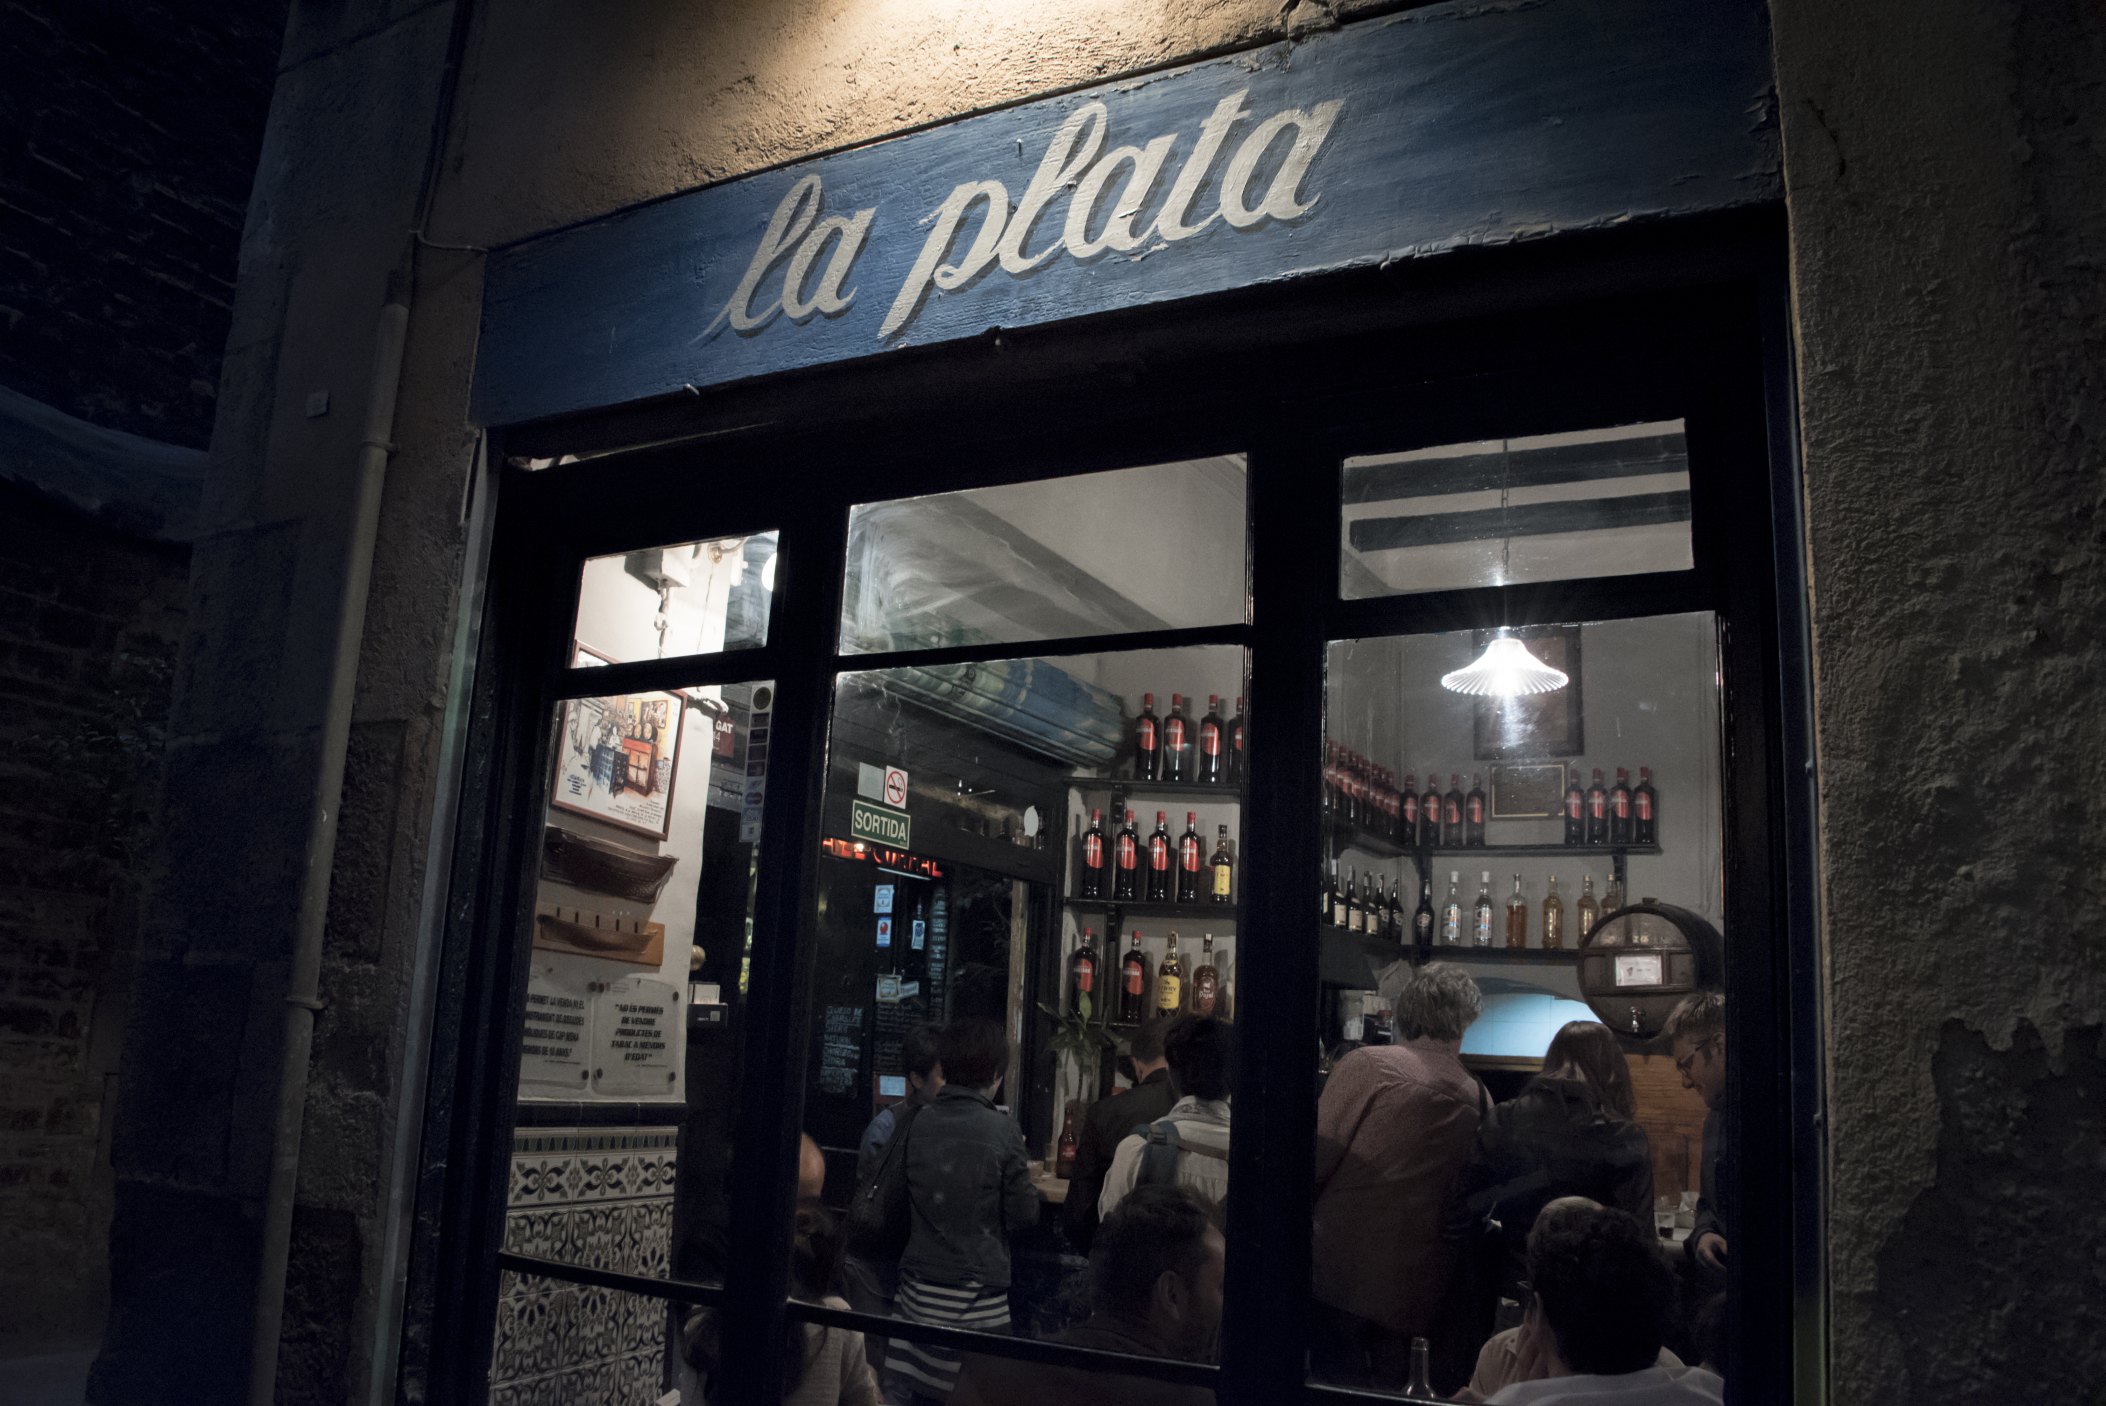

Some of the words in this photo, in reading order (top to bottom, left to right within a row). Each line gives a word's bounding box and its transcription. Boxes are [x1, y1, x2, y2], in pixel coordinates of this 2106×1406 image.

[694, 173, 876, 345] la
[877, 88, 1347, 340] plata
[855, 809, 907, 841] SORTIDA
[611, 1040, 633, 1049] TABAC
